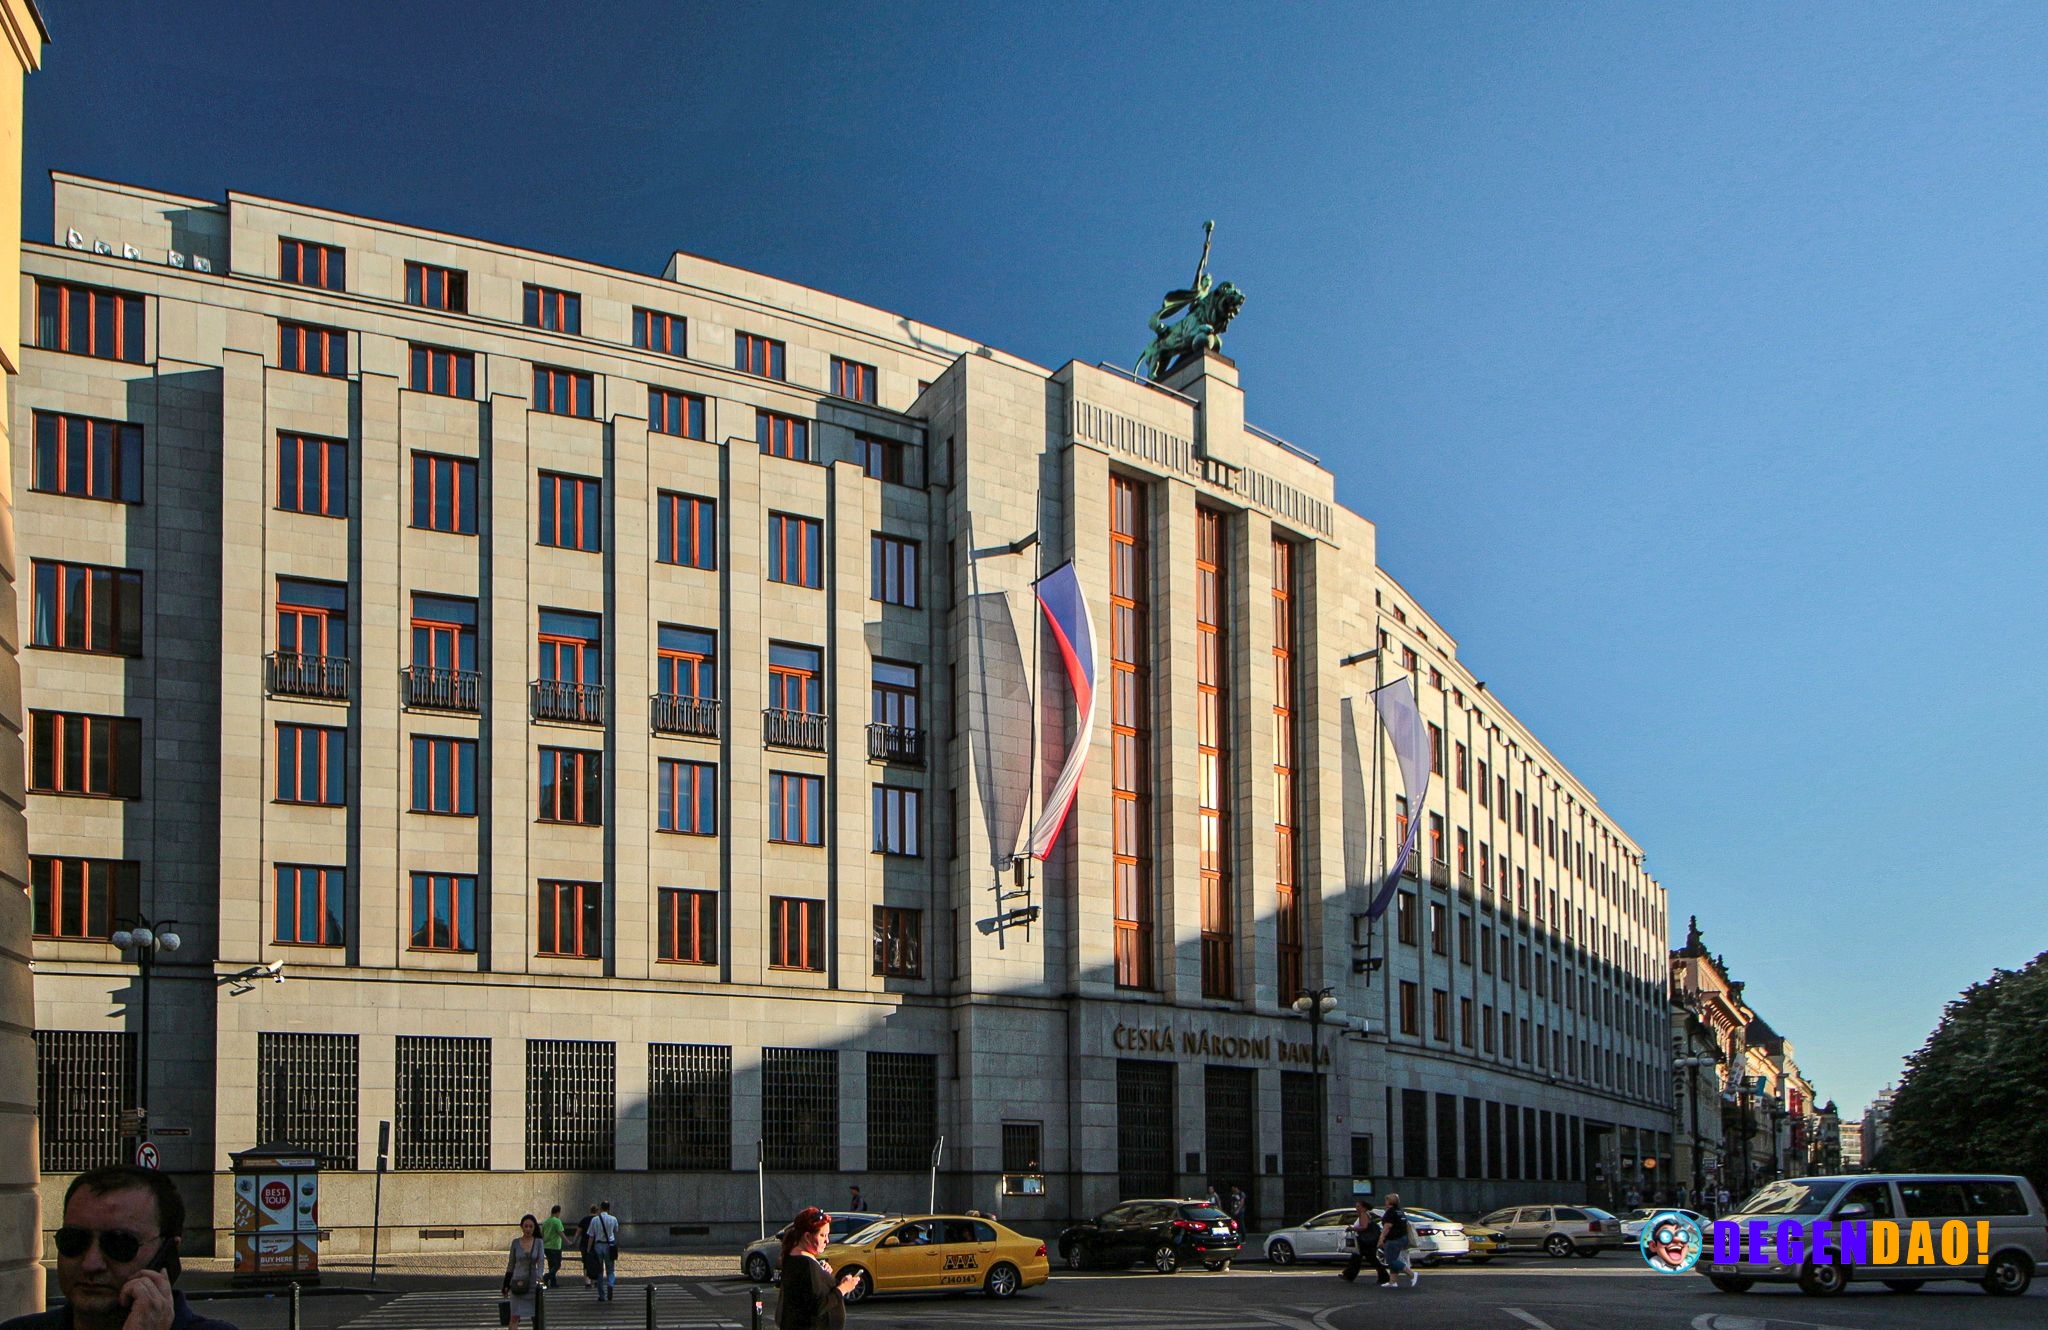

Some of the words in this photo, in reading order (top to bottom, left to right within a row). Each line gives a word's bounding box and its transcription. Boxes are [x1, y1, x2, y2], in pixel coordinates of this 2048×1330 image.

[1113, 1023, 1174, 1053] ČESKÁ
[1183, 1029, 1270, 1061] NÁRODNÍ
[265, 1188, 287, 1196] BEST
[943, 1253, 978, 1270] AAA
